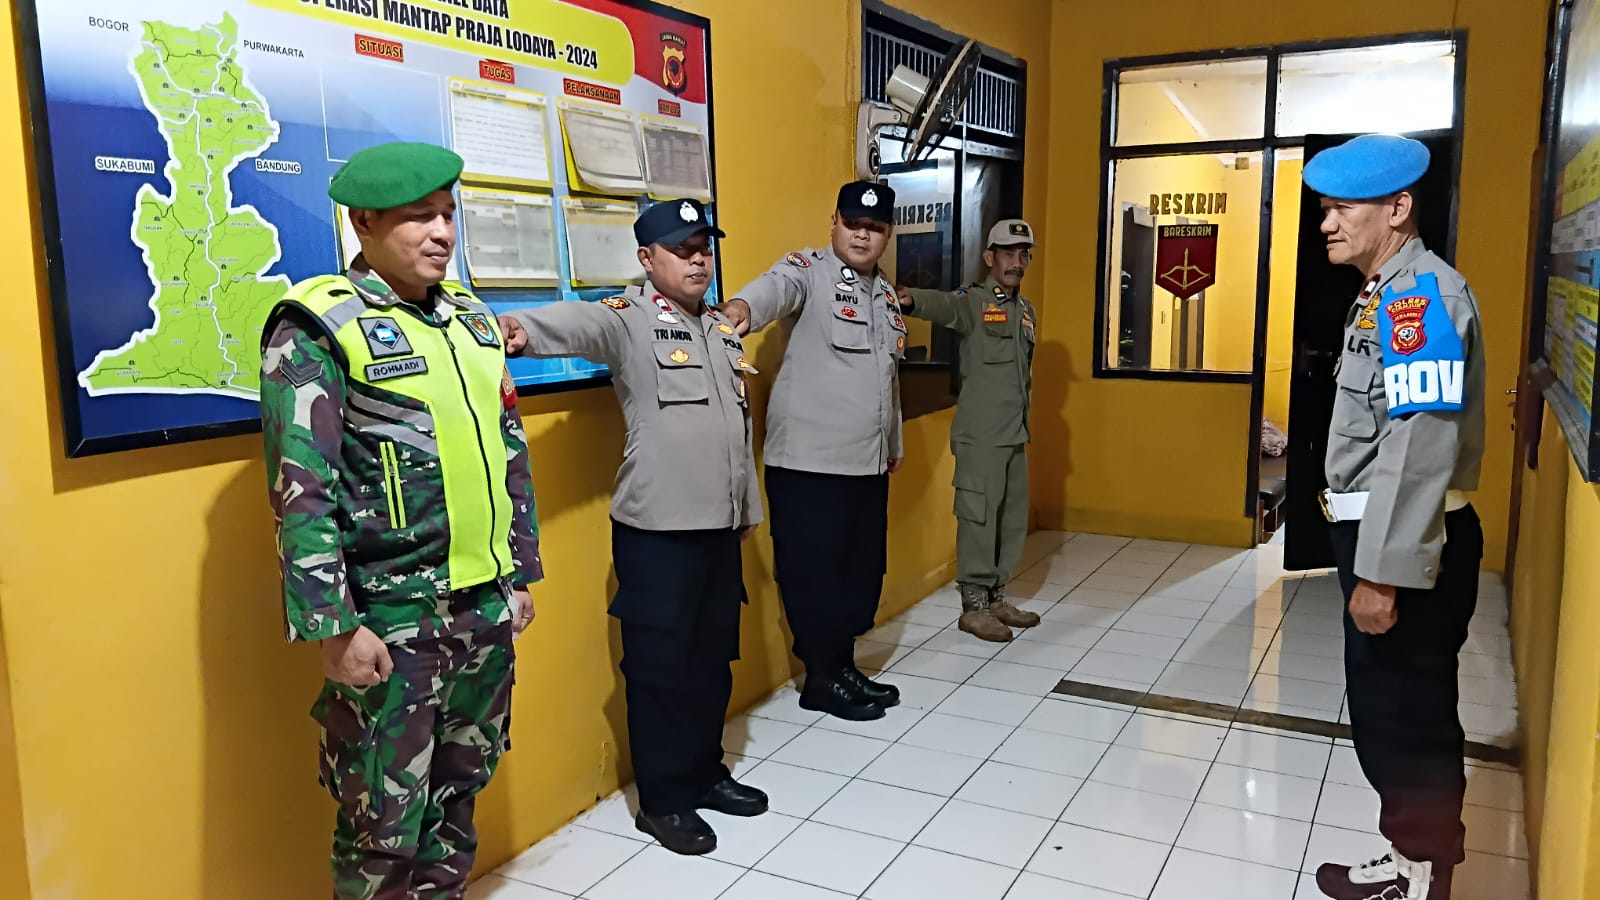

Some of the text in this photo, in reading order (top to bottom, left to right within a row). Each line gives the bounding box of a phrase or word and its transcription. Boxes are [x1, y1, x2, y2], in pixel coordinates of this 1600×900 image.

[88, 16, 130, 32] BOGOR
[301, 0, 378, 19] RASI
[383, 0, 452, 35] MANTAP
[456, 16, 503, 47] PRAJA
[506, 28, 557, 60] LODAYA
[566, 44, 598, 69] 2024
[243, 39, 305, 59] PURWAKARTA
[359, 39, 403, 59] SITUASI
[483, 65, 511, 80] TUGAS
[566, 82, 620, 103] PELAKSANAAN
[96, 158, 154, 173] SUKABUMI
[256, 160, 301, 174] BANDUNG
[1149, 193, 1227, 215] RESKRIM
[1163, 226, 1212, 237] BARESKRIM
[835, 293, 858, 305] BAYU
[1387, 297, 1427, 312] POLRES
[653, 328, 669, 341] TRI
[373, 361, 419, 377] ROHMADI
